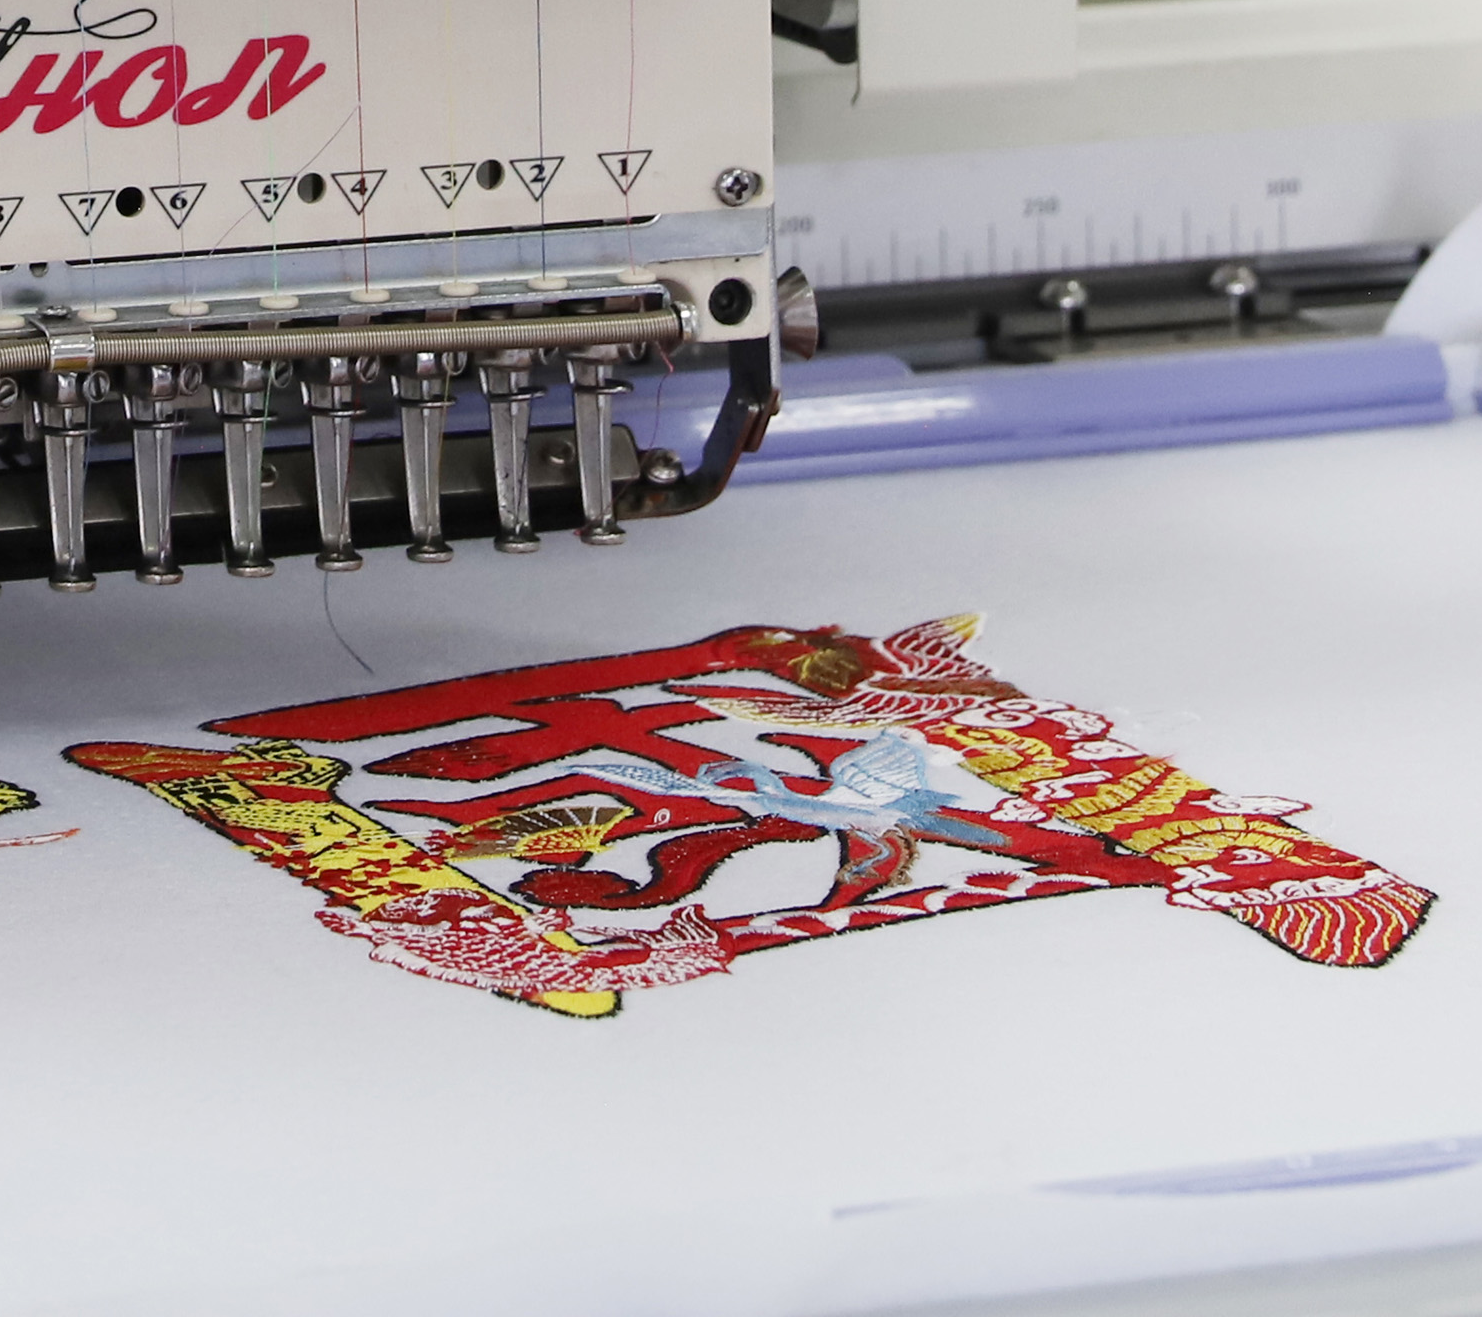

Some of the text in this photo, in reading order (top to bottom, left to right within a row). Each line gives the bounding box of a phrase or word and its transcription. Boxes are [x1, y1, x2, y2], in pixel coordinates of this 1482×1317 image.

[78, 196, 97, 218] 7
[169, 190, 188, 211] 6
[261, 182, 280, 204] 5
[349, 176, 369, 196] 4
[439, 170, 458, 190] 3
[529, 164, 547, 184] 2
[617, 157, 630, 177] 1
